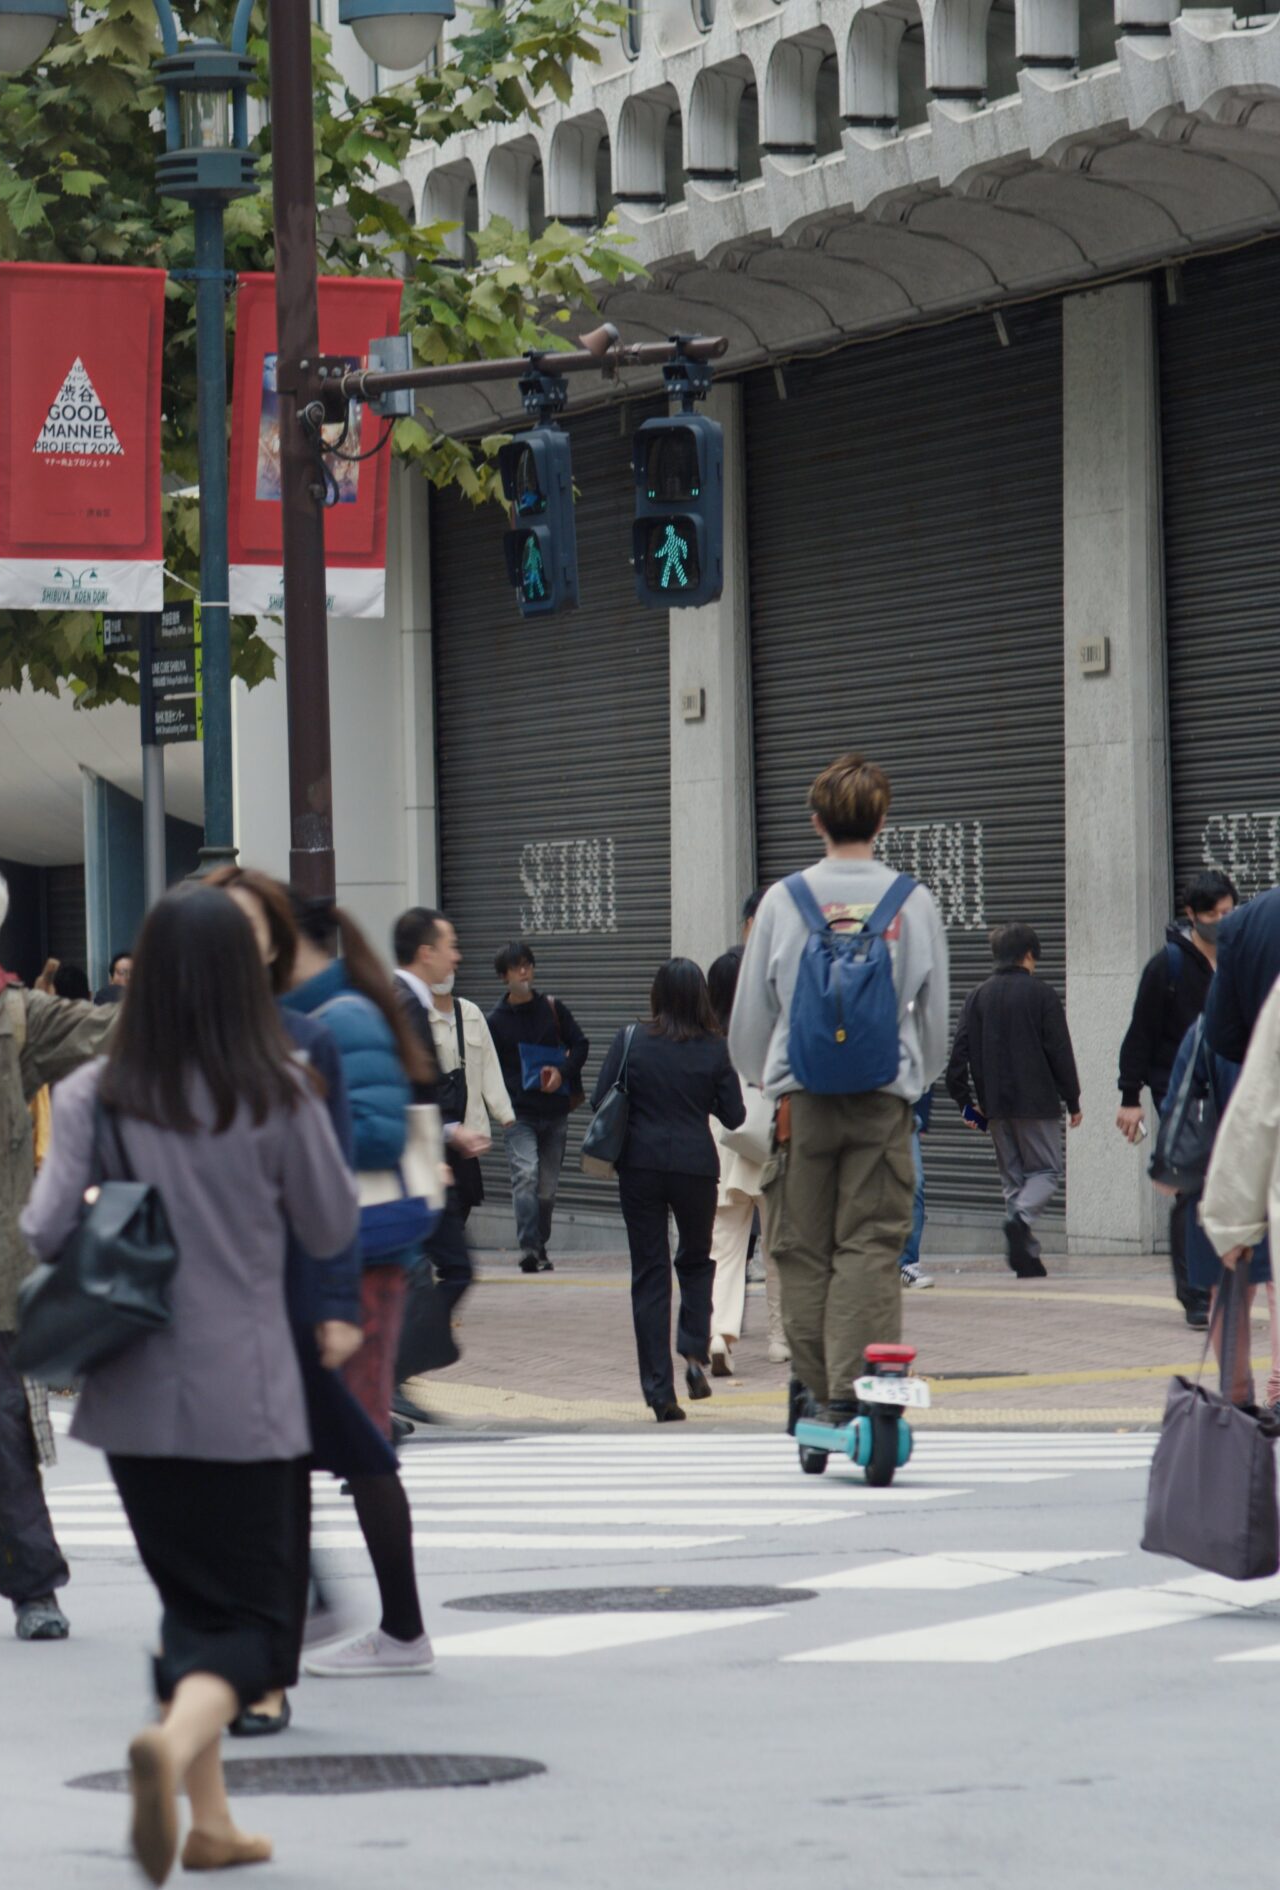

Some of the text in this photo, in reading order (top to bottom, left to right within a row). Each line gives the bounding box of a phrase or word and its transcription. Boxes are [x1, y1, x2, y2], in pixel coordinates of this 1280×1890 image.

[60, 383, 94, 403] 渋谷
[48, 404, 107, 422] GOOD
[43, 423, 115, 439] MANNER
[34, 441, 123, 456] PROJECT 2022
[41, 589, 70, 604] SHIBUYA
